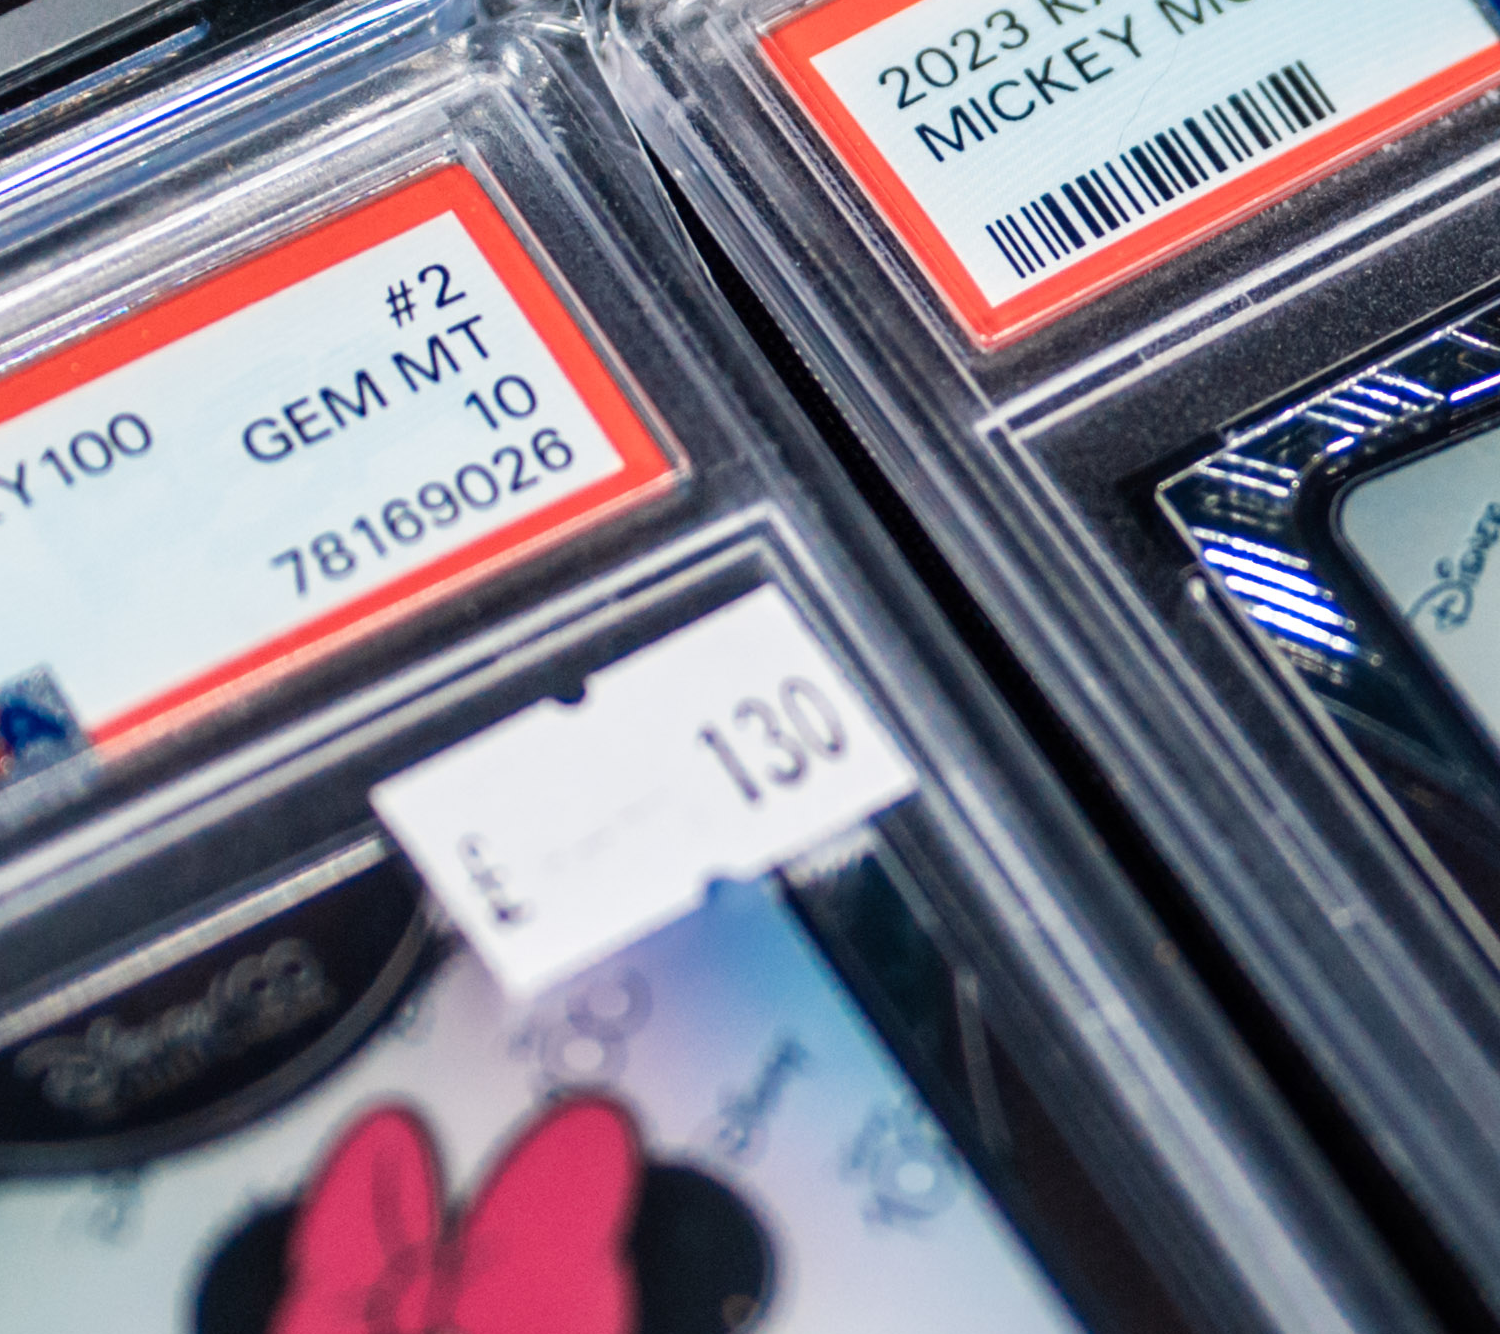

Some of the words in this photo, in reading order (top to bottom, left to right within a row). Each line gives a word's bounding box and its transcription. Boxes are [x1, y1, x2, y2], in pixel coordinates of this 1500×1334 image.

[879, 8, 1031, 110] 2023
[914, 13, 1143, 164] MICKEY
[385, 263, 467, 329] #2
[241, 367, 390, 464] GEM
[390, 314, 490, 393] MT
[463, 374, 539, 431] 10
[270, 427, 576, 598] 78169026
[697, 674, 851, 808] 130
